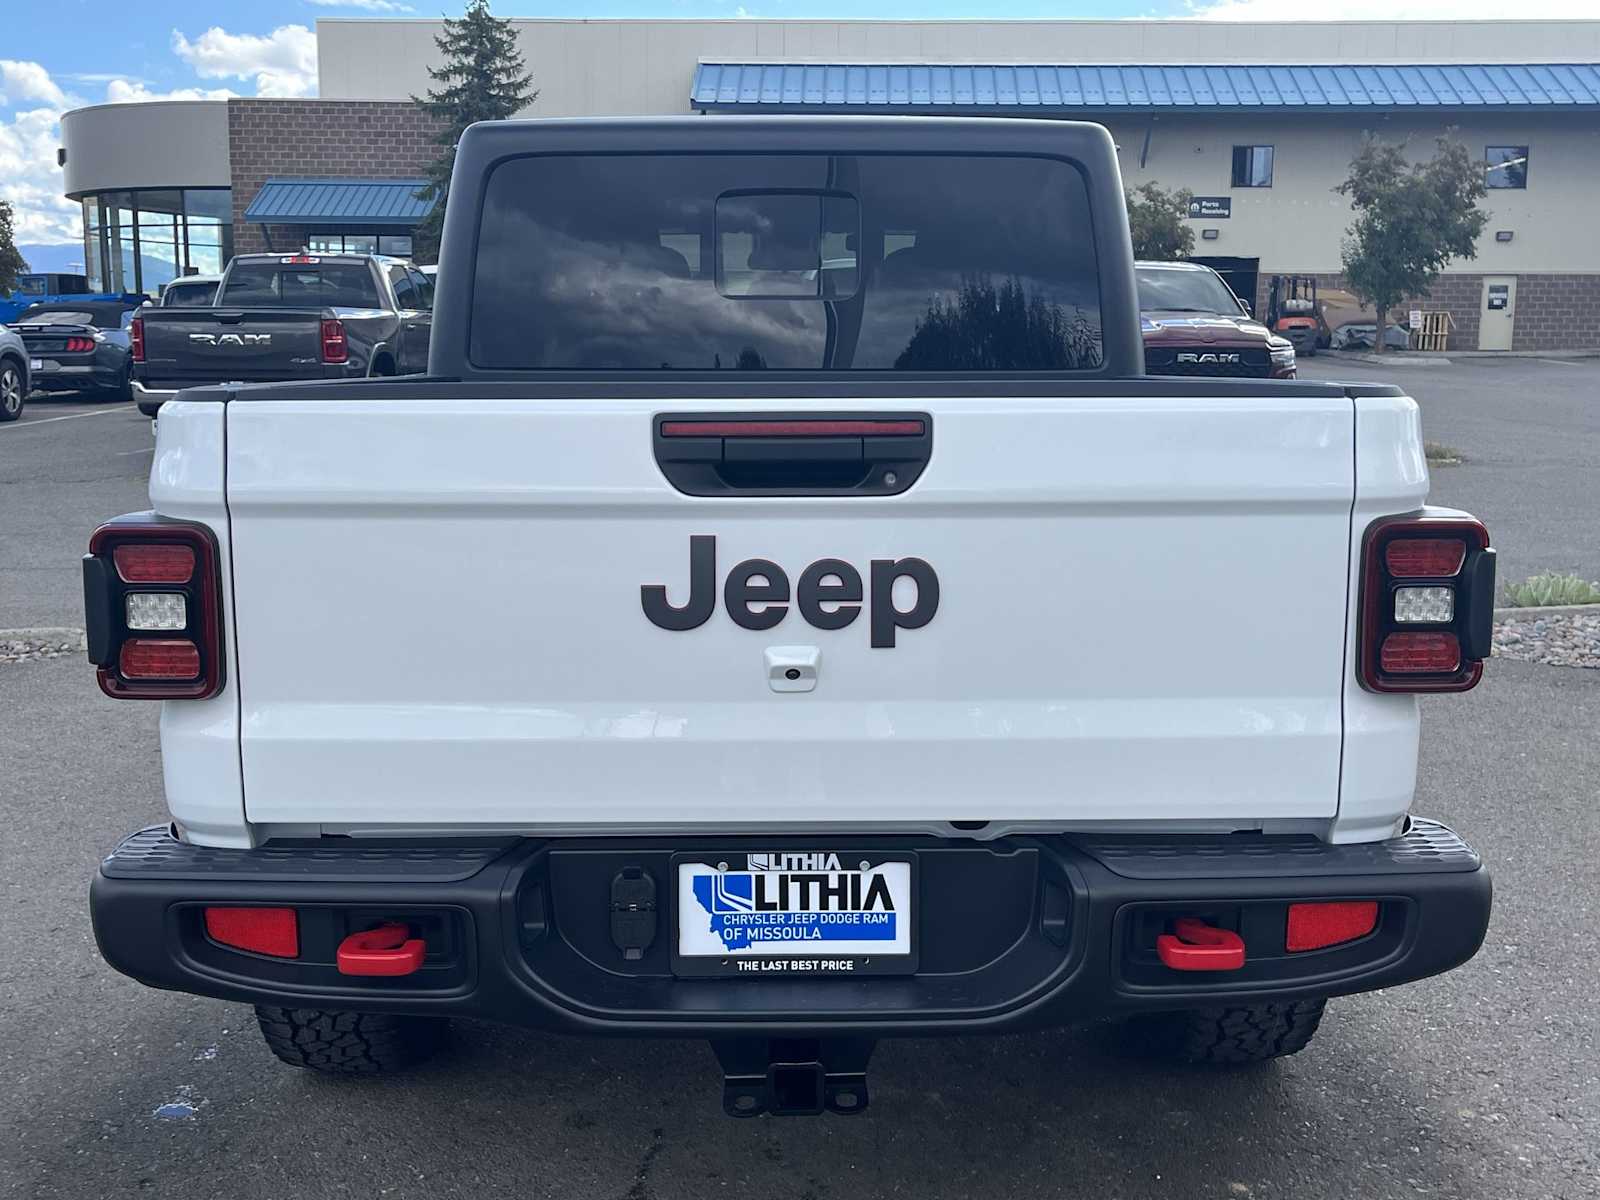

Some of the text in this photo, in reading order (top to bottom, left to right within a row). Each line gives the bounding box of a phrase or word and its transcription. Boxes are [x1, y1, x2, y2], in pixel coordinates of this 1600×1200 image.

[189, 334, 271, 346] RAM
[1177, 353, 1240, 363] RAM
[640, 535, 940, 649] Jeep
[768, 853, 842, 871] LITHIA
[755, 874, 895, 911] LITHIA
[723, 913, 889, 925] CHRYSLER JEEP DODGE RAM
[723, 927, 822, 940] OF MISSOULA
[737, 960, 854, 970] THE LAST BEST PRICE
